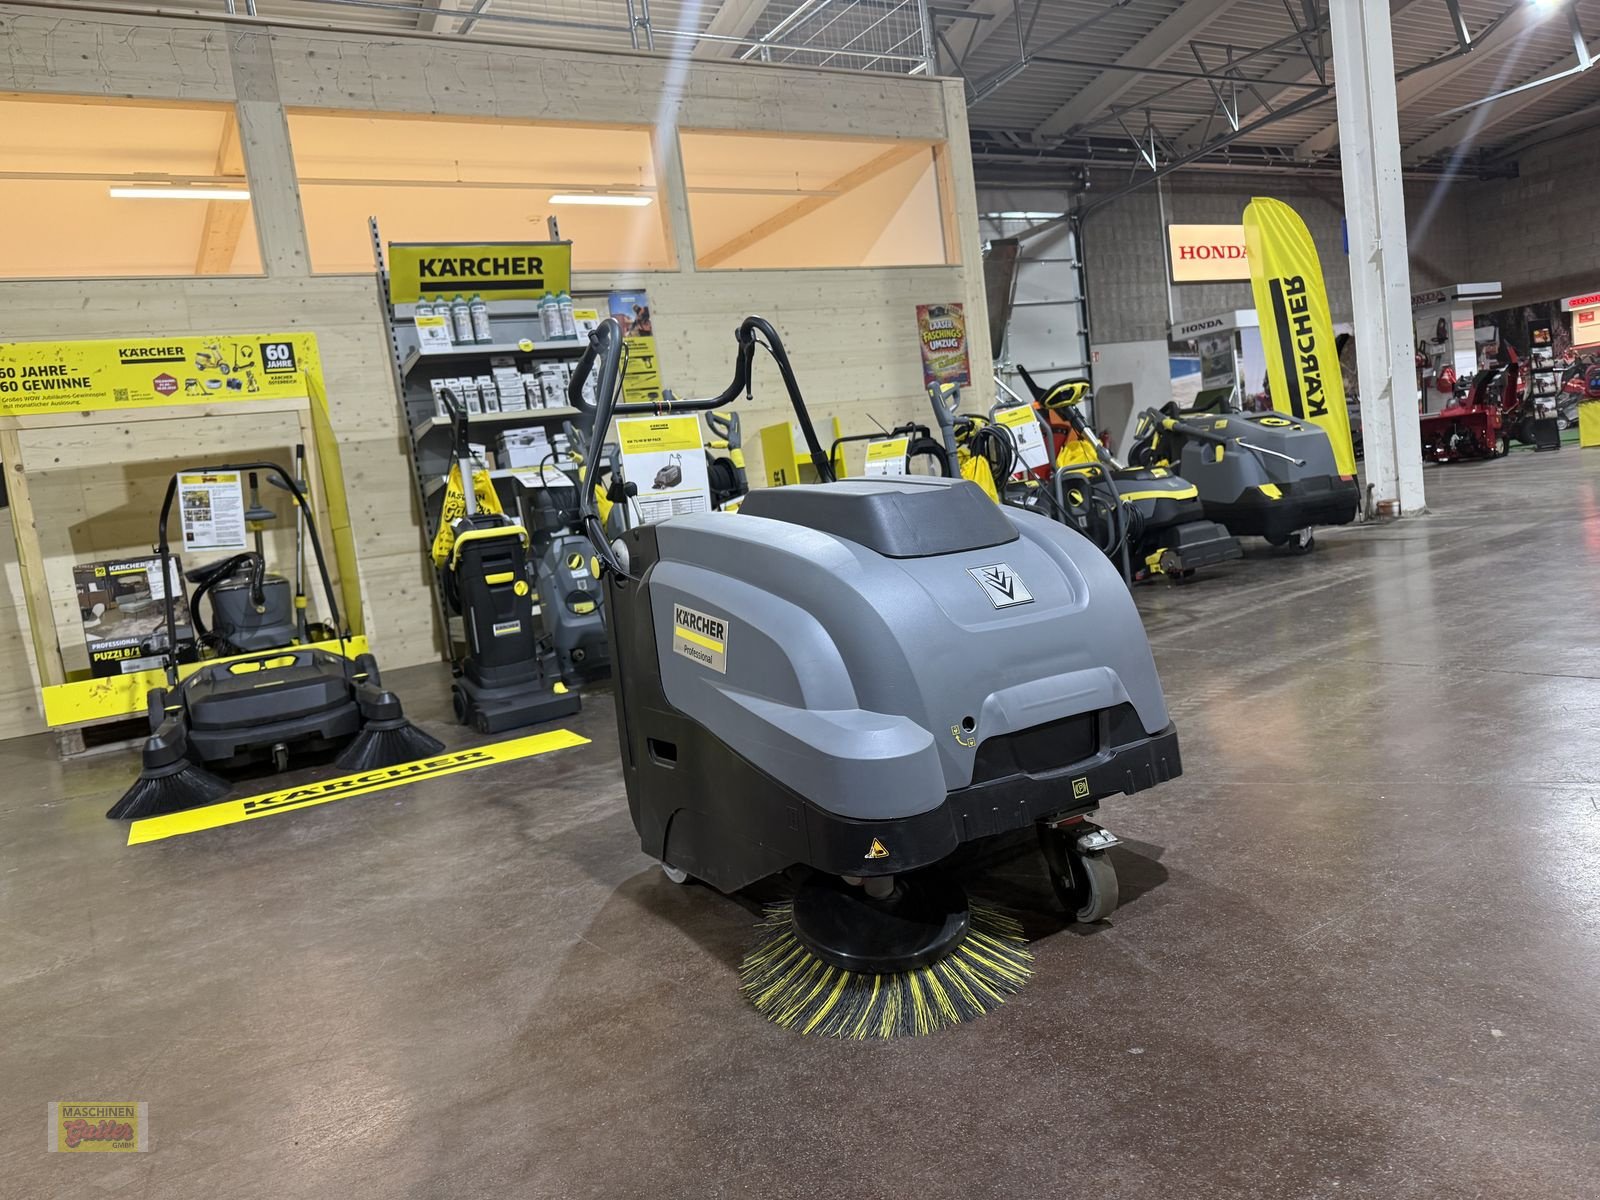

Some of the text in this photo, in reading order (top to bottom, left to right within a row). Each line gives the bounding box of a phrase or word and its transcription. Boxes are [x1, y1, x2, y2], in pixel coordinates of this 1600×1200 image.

[419, 257, 544, 277] KÄRCHER
[1182, 319, 1223, 334] HONDA
[923, 329, 961, 343] FASCHINGS
[119, 347, 184, 357] KÄRCHER
[266, 344, 289, 360] 60
[930, 339, 957, 350] UMZUG
[20, 365, 67, 378] JAHRE
[267, 360, 293, 369] JAHRE
[0, 377, 91, 392] 60 GEWINNE
[676, 608, 724, 640] KÄRCHER
[92, 638, 139, 650] PROFESSIONAL
[94, 647, 140, 662] PUZZI 8/1
[684, 644, 713, 664] Professional
[244, 751, 486, 810] KÄRCHER
